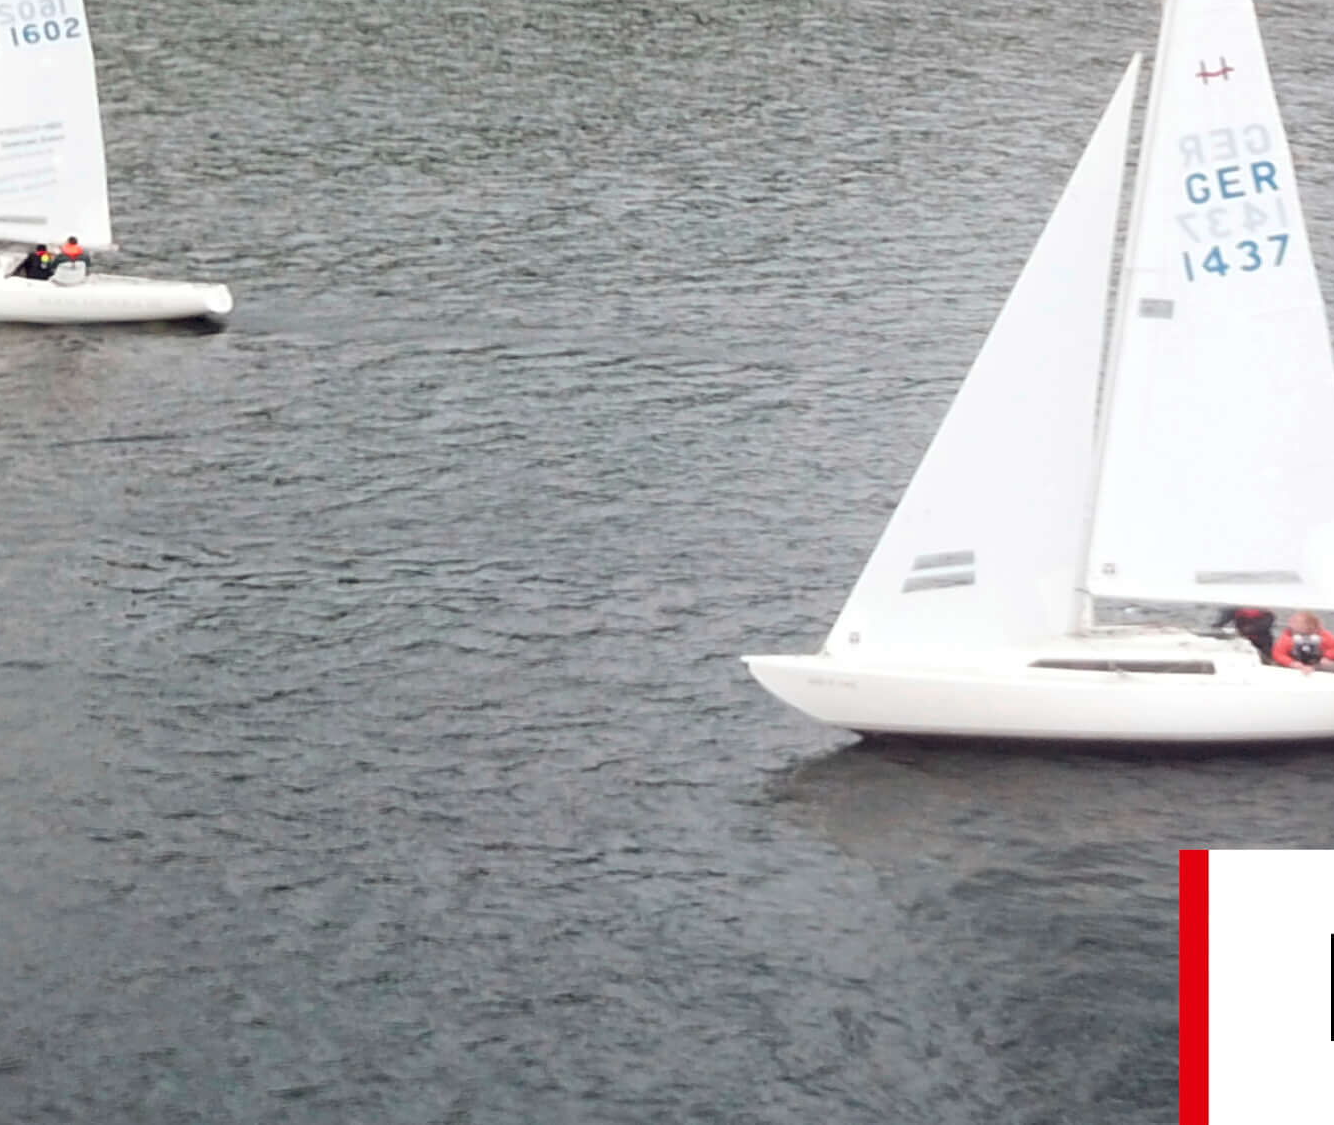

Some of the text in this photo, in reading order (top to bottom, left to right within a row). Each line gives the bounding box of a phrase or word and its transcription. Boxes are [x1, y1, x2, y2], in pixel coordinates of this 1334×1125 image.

[11, 17, 81, 47] 1602
[1185, 161, 1279, 204] GER
[1183, 233, 1289, 282] 1437
